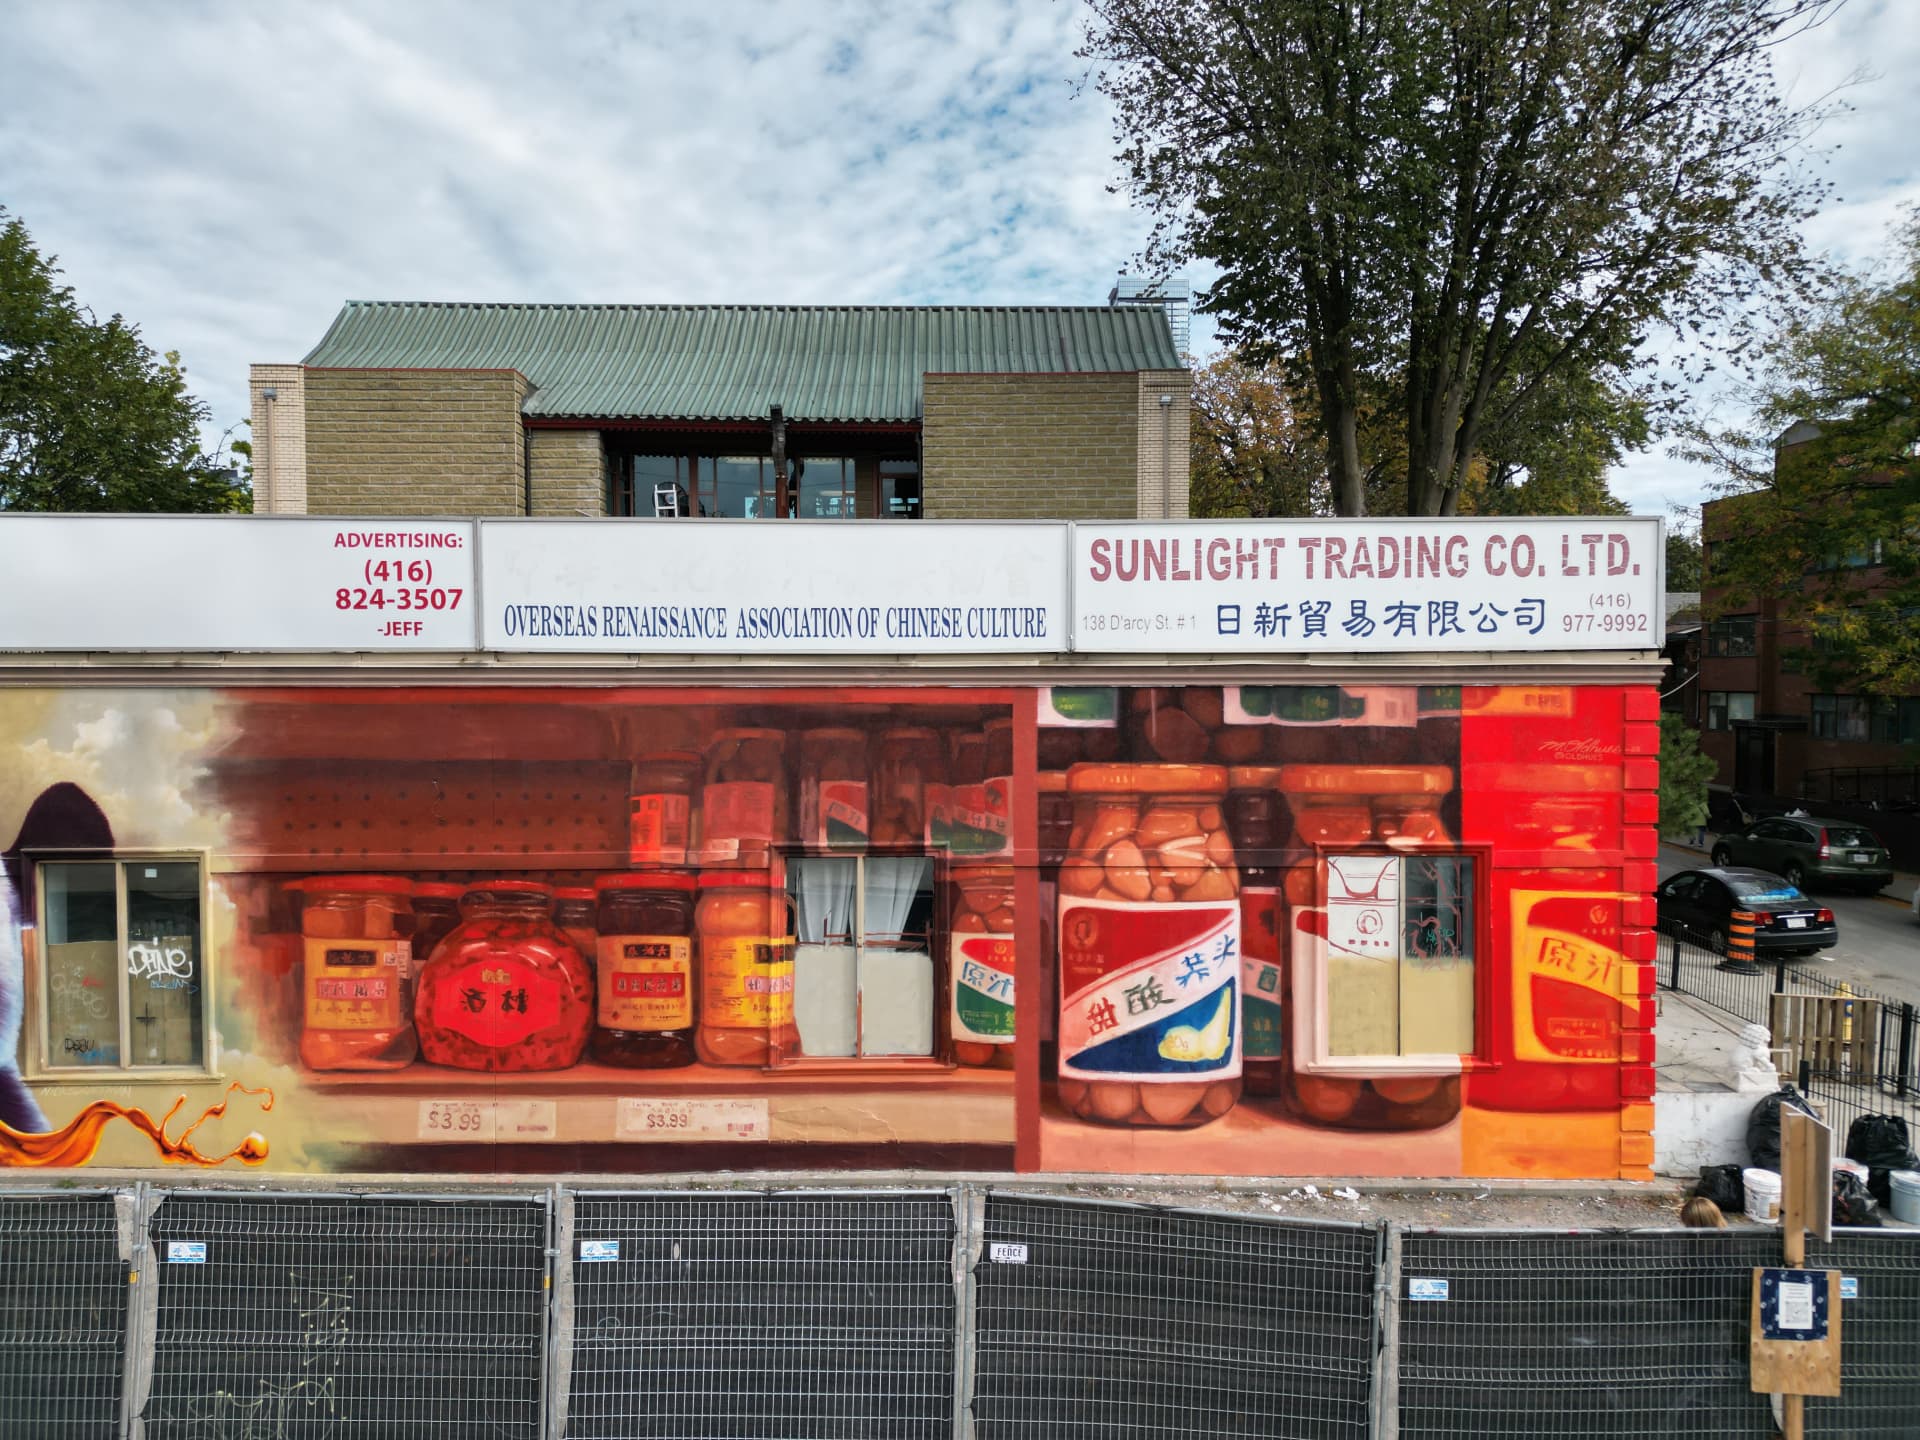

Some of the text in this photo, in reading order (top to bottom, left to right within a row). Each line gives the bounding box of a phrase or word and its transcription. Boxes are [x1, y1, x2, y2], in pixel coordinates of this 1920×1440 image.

[334, 533, 464, 548] ADVERTISING:
[1090, 537, 1286, 582] SUNLIGHT
[1298, 536, 1469, 579] TRADING
[1484, 534, 1546, 577] CO.
[1561, 534, 1641, 576] LTD.
[365, 559, 432, 585] (416)
[335, 588, 463, 610] 824-3507
[1588, 592, 1632, 610] (416)
[504, 604, 1047, 639] OVERSEAS RENAISSANCE ASSOCIATION OF CHINESE CULTURE
[1082, 614, 1106, 631] 138
[1110, 613, 1150, 634] D'arcy
[1155, 613, 1174, 631] St.
[1217, 598, 1546, 638] 日新貿易有限公司
[1562, 613, 1648, 632] 977-9992
[377, 621, 424, 637] -JEFF
[428, 1110, 481, 1132] $3.99
[647, 1113, 688, 1129] $3.99
[997, 1247, 1023, 1258] FENCE
